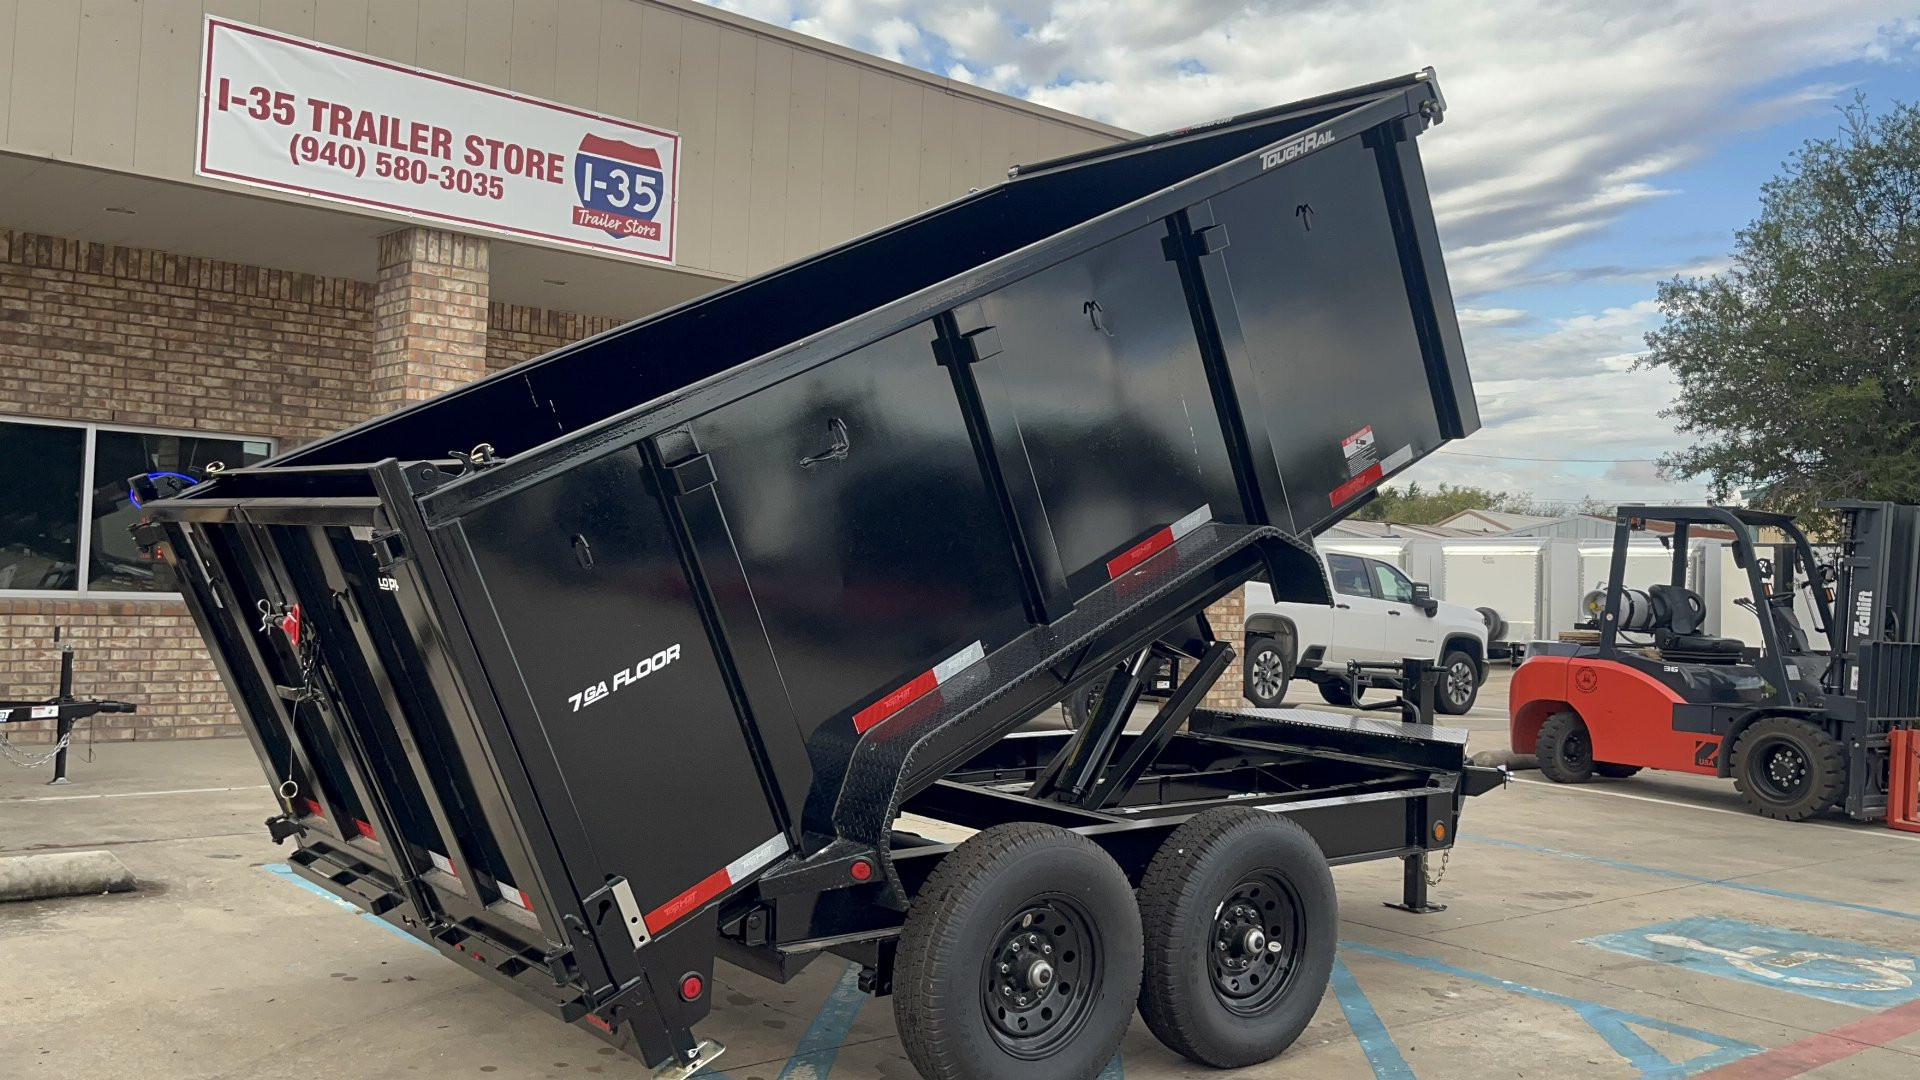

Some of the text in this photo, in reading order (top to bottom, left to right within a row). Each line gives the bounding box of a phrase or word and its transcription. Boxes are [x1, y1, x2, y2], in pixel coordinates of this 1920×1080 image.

[217, 78, 565, 185] I-35 TRAILER STORE
[289, 133, 504, 200] (940) 580-3035
[582, 162, 658, 213] I-35
[578, 209, 656, 237] Trailer Store
[1853, 590, 1873, 637] Tailift
[612, 643, 681, 692] FLOOR
[1699, 758, 1715, 767] USA
